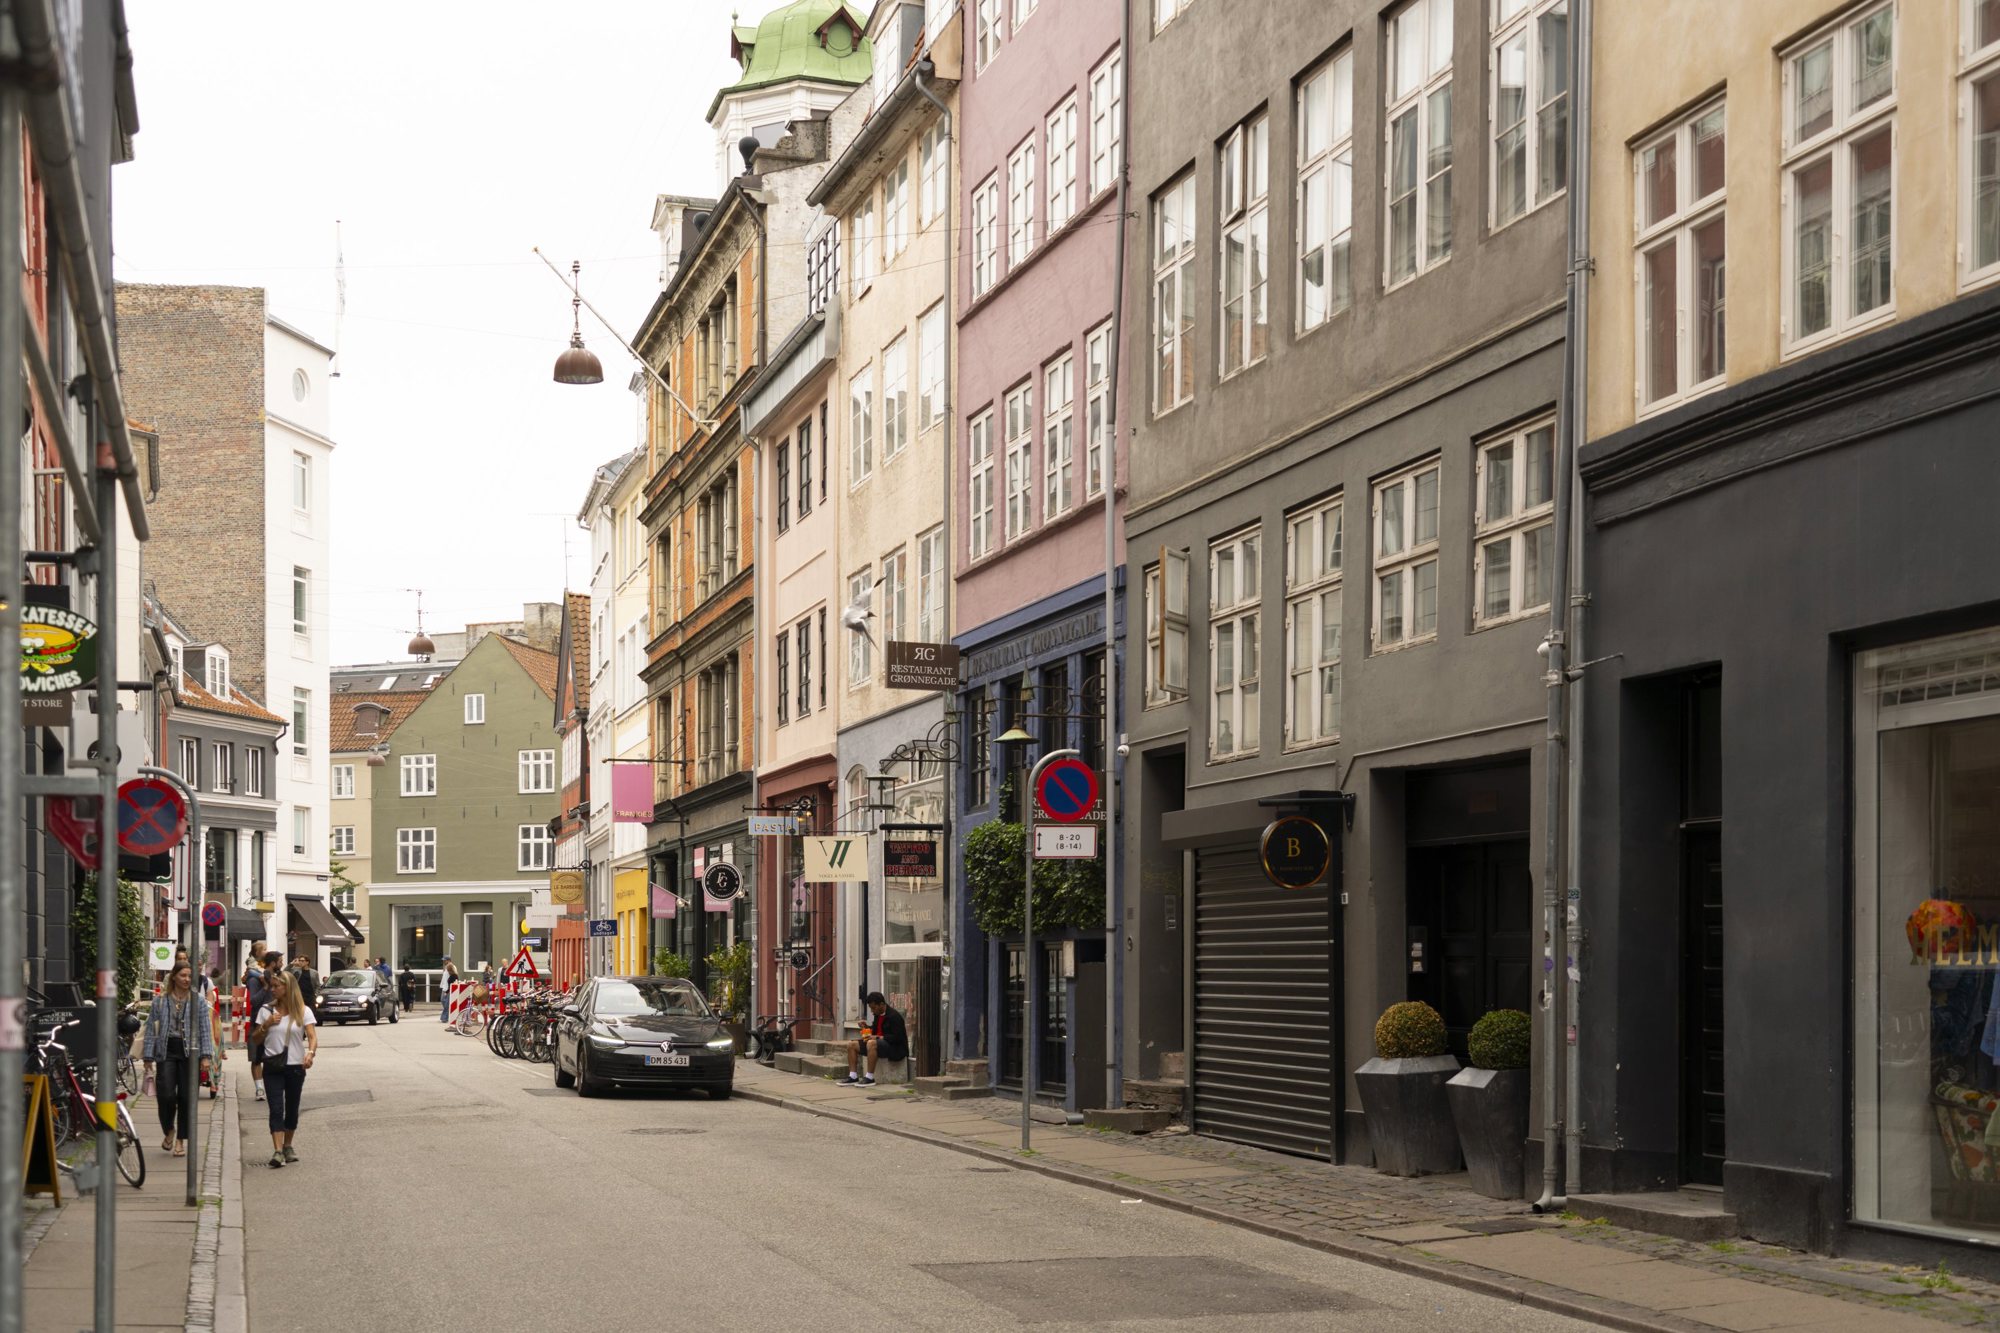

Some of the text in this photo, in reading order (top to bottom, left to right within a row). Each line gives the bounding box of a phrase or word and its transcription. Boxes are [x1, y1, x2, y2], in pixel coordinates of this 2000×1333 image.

[891, 664, 953, 675] RESTAURANT
[890, 674, 957, 686] GRØNNEGADE
[31, 699, 63, 708] STORE
[754, 823, 792, 833] PASTA
[890, 842, 930, 854] TATTOO
[1287, 837, 1301, 857] B
[901, 854, 920, 864] AND
[887, 865, 936, 876] PIERCING
[651, 1056, 688, 1065] DM 85 431
